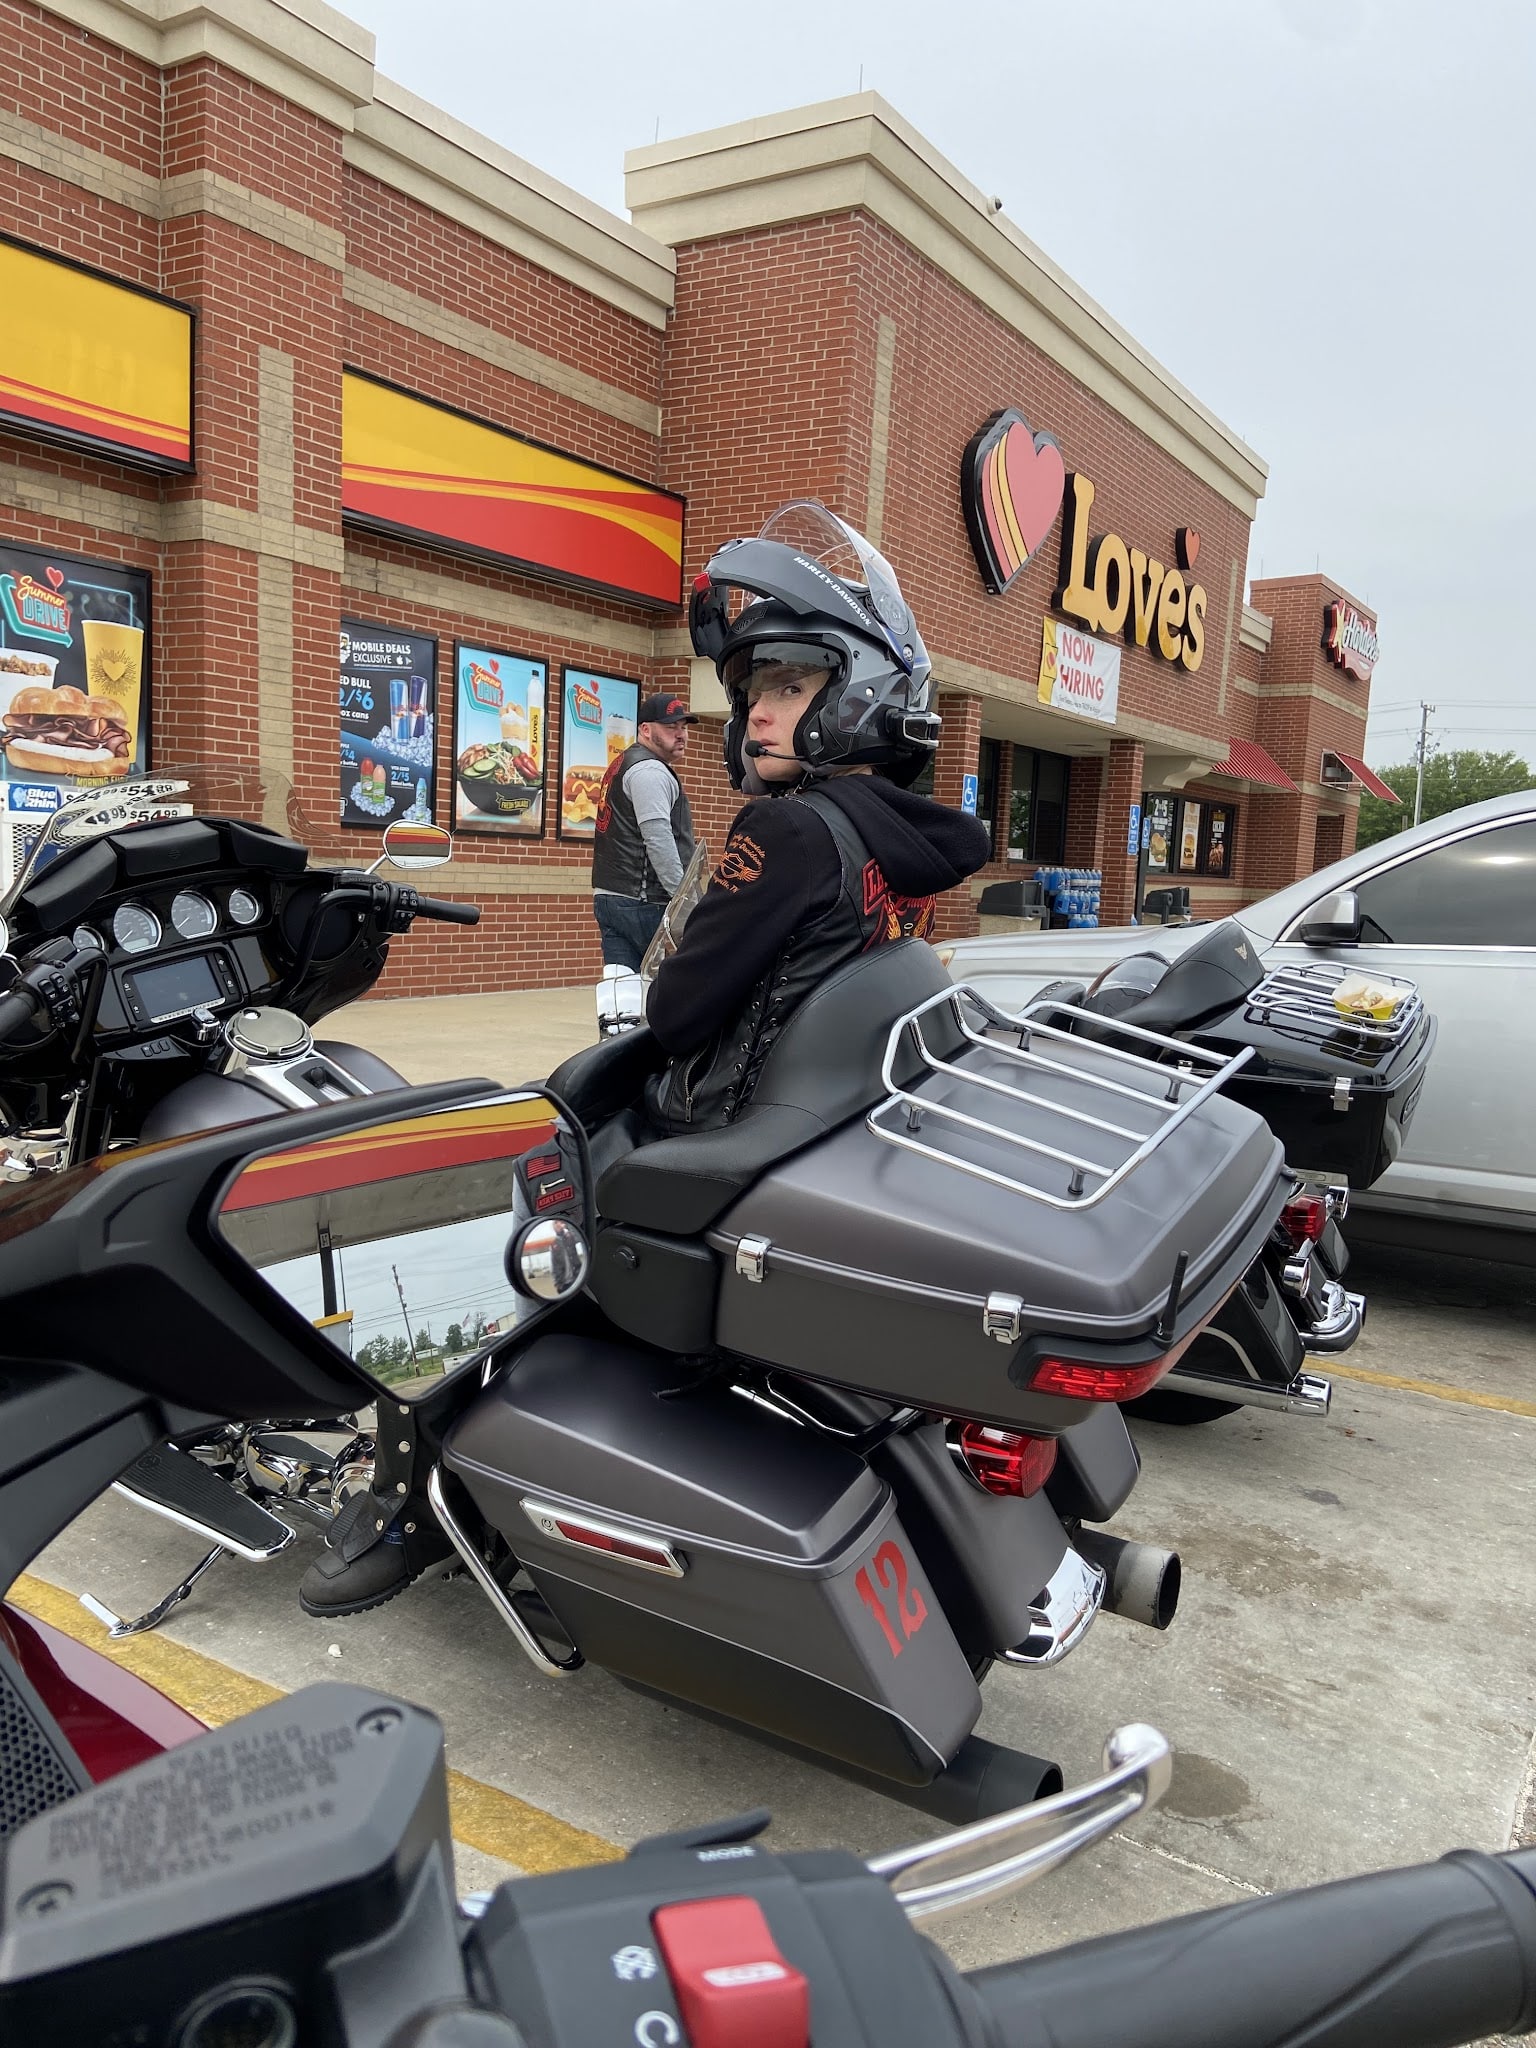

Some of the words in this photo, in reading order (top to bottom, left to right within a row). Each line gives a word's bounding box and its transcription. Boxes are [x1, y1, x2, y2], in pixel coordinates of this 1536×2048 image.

[17, 575, 65, 606] Summer
[793, 556, 872, 627] HARLEY-DAVIDSON
[23, 596, 67, 630] DRIVE
[352, 641, 385, 653] MOBILE
[385, 643, 411, 654] DEALS
[1062, 631, 1095, 667] NOW
[352, 652, 392, 664] EXCLUSIVE
[351, 677, 371, 689] BULL
[1060, 664, 1105, 701] HIRING
[352, 711, 369, 719] cans
[27, 788, 56, 799] Blue
[25, 799, 57, 809] Rhin
[854, 1540, 929, 1660] 12
[697, 1845, 757, 1862] MODE
